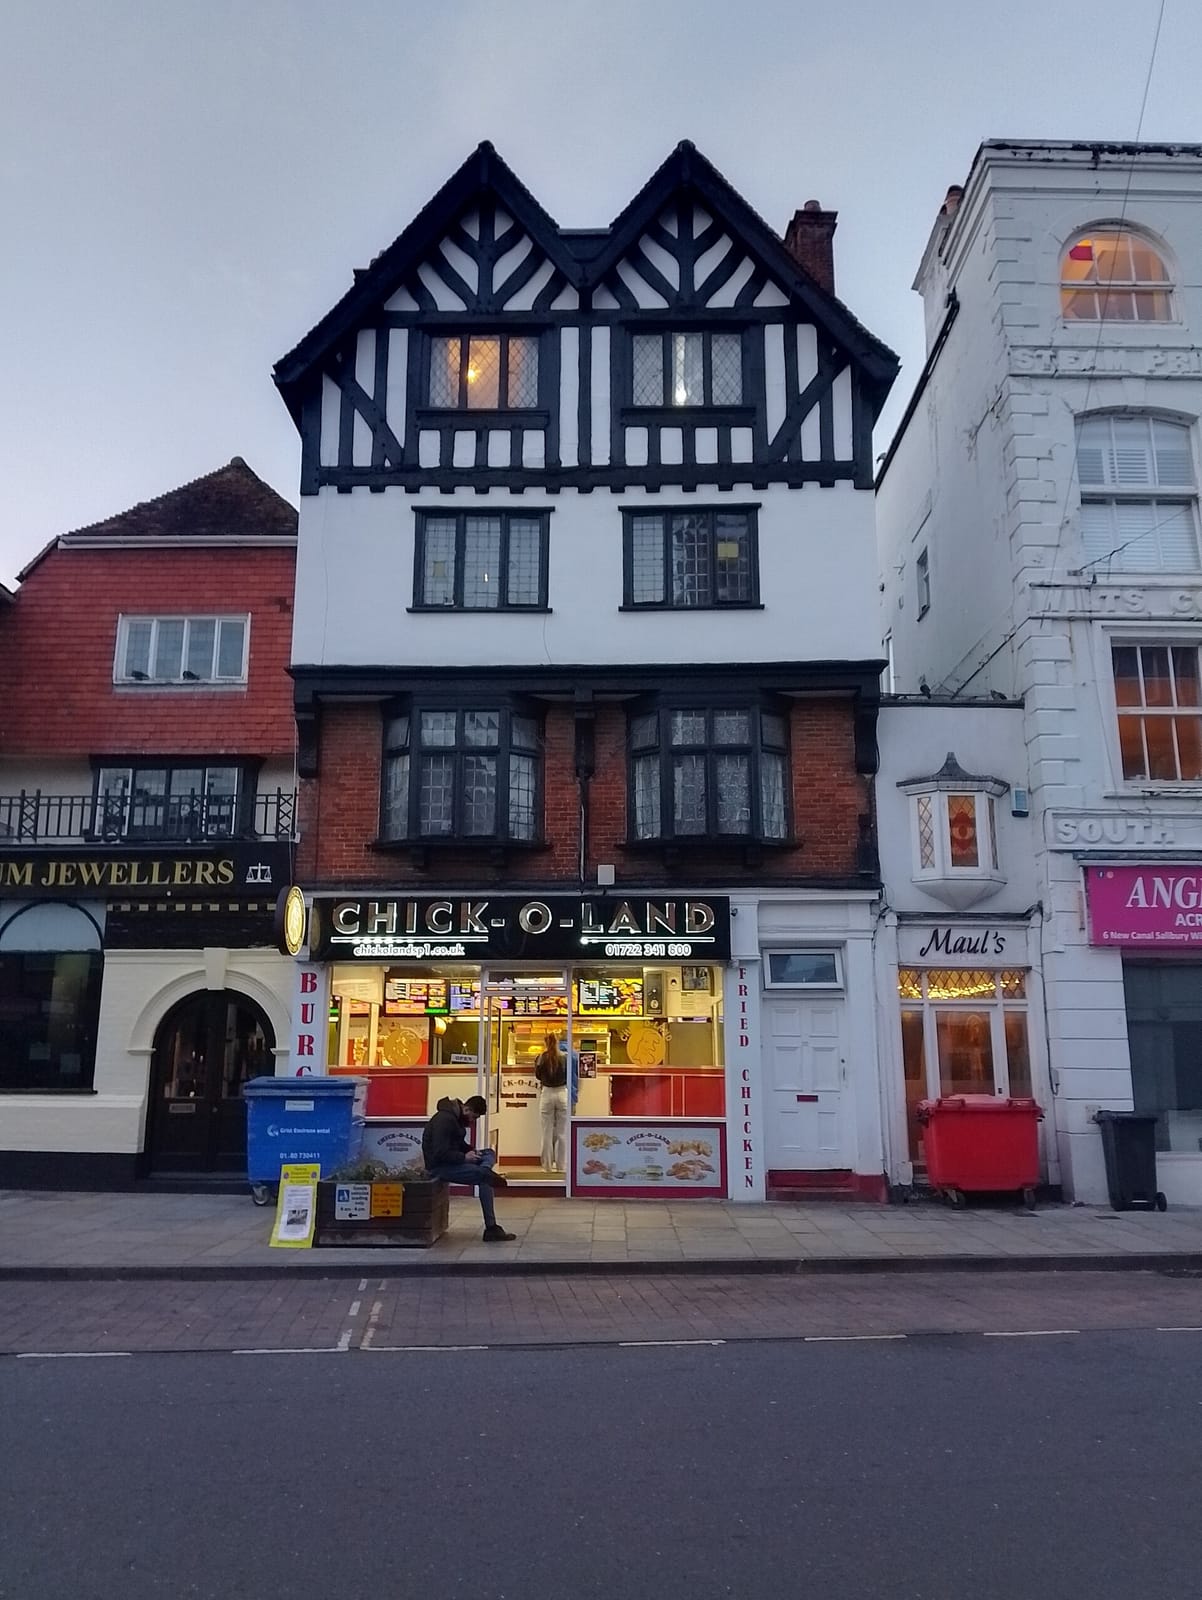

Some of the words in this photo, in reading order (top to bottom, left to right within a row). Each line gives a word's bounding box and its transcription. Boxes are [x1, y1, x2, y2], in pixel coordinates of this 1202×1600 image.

[1056, 818, 1175, 844] SOUTH
[41, 860, 235, 886] JEWELLERS
[1125, 876, 1202, 909] ANG
[920, 928, 1006, 957] Maul's
[1131, 931, 1155, 940] Canal
[605, 944, 643, 957] 01722
[644, 944, 666, 957] 341
[738, 968, 750, 1047] FRIED
[740, 1069, 754, 1188] CHICKEN
